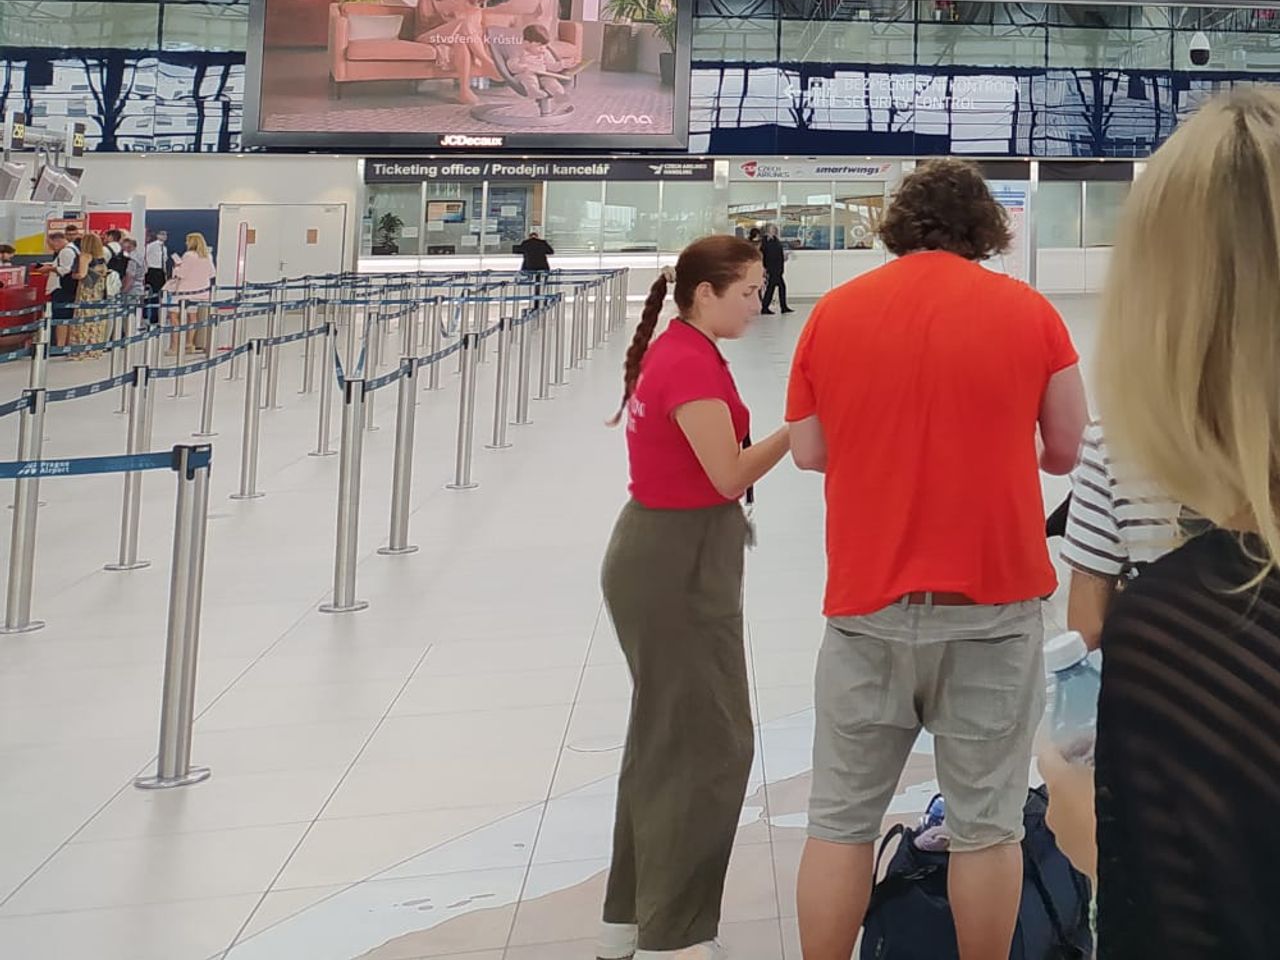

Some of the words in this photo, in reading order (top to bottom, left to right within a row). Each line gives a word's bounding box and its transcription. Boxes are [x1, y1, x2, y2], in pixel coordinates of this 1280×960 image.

[440, 135, 503, 146] JCDecaux
[373, 163, 437, 177] Ticketing
[441, 163, 480, 175] office
[491, 163, 549, 177] Prodejní
[552, 162, 611, 176] kancelář
[815, 165, 879, 176] smartwings
